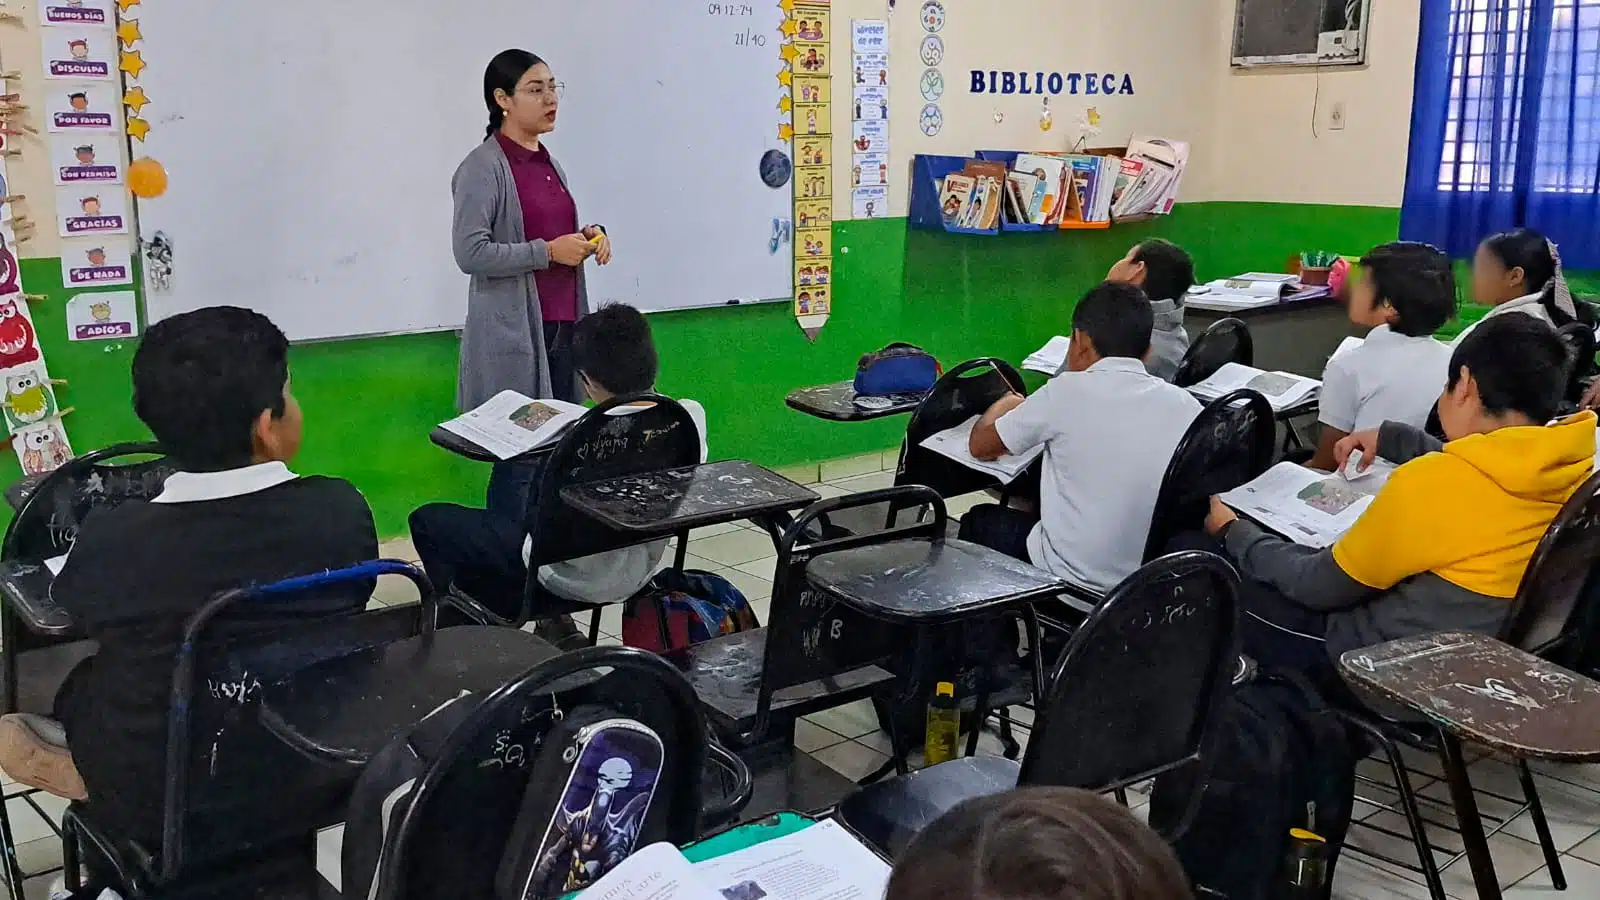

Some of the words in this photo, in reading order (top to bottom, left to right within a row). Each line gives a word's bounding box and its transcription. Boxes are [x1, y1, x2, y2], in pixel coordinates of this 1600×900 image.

[48, 11, 82, 19] BUENOS
[57, 64, 105, 73] DISCULPA
[969, 69, 1135, 95] BIBLIOTECA
[58, 116, 78, 124] POR
[80, 116, 109, 124] FAVOR
[61, 170, 79, 178] CON
[72, 219, 118, 229] GRACIAS
[77, 271, 91, 280] DE
[93, 270, 121, 279] NADA
